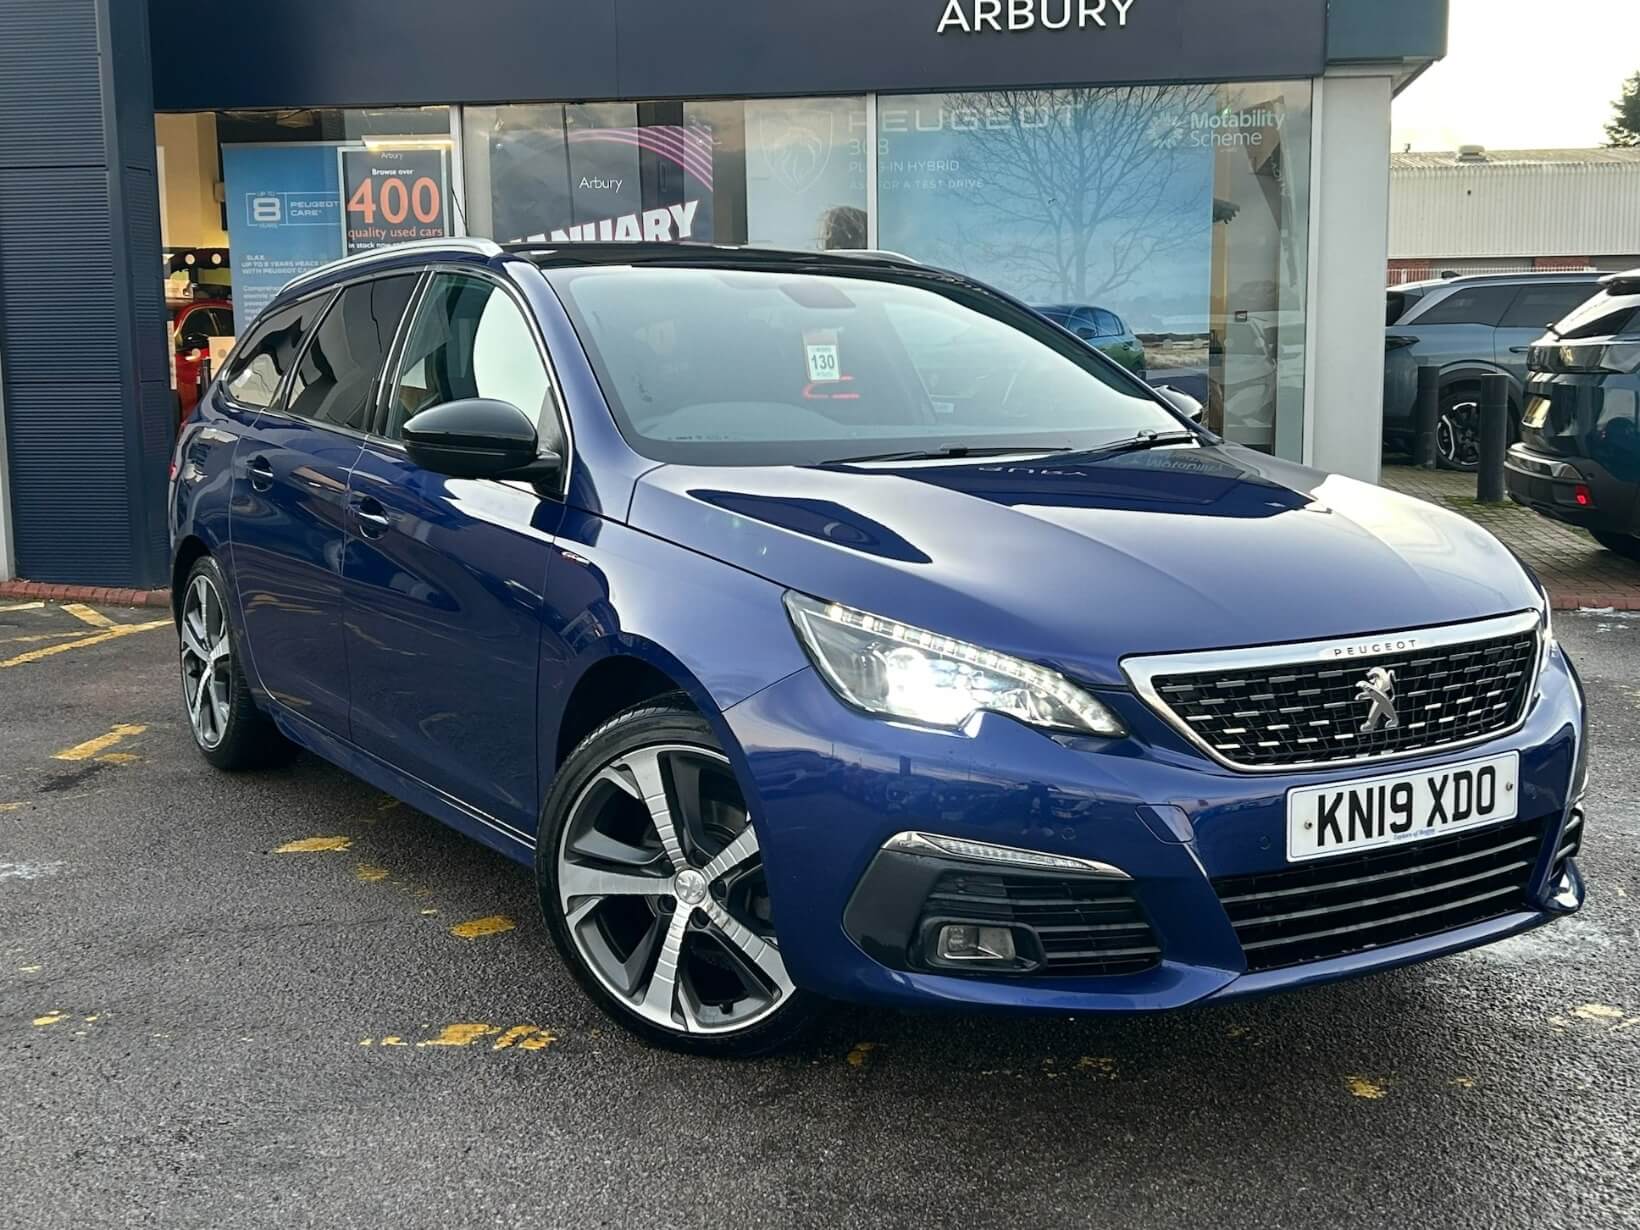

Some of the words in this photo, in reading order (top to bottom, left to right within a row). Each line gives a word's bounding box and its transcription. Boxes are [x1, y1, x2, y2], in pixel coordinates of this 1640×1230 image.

[937, 0, 1134, 33] ARBURY
[848, 104, 1083, 133] PEUGEOT
[1191, 110, 1285, 130] Motability
[1191, 131, 1263, 147] Scheme
[381, 152, 403, 160] Arbury
[907, 159, 960, 171] HYBRID
[579, 177, 622, 192] Arbury
[290, 200, 339, 208] PEUGEOT
[347, 177, 440, 224] 400
[253, 198, 281, 221] 8
[348, 226, 386, 241] quality
[390, 226, 416, 237] used
[420, 226, 443, 237] cars
[811, 354, 835, 370] 130
[1334, 638, 1418, 657] PEUGEOT
[1317, 781, 1414, 847] KN19
[1426, 765, 1496, 827] XDO
